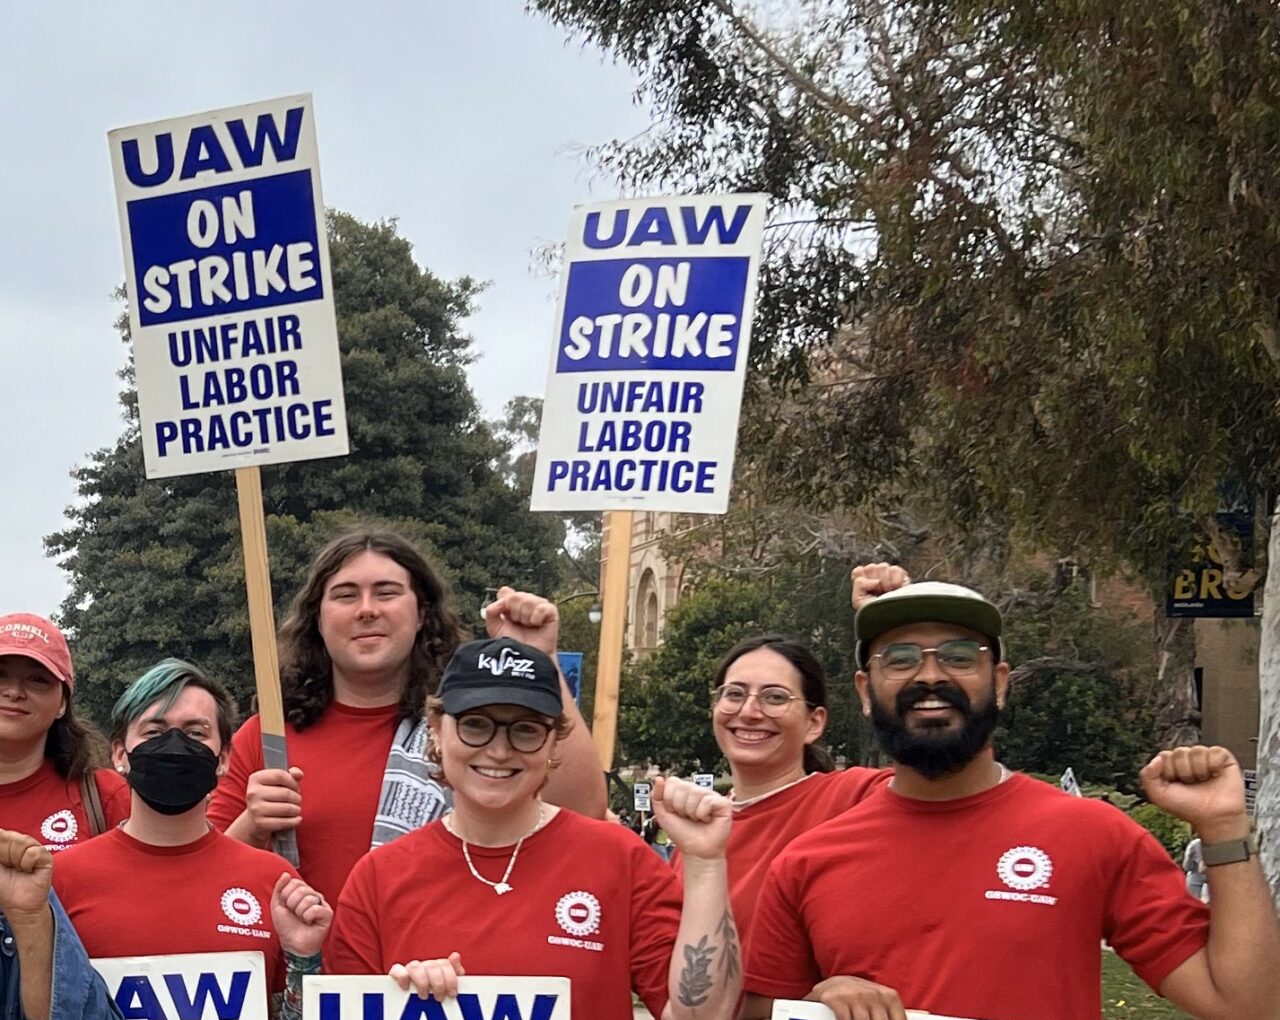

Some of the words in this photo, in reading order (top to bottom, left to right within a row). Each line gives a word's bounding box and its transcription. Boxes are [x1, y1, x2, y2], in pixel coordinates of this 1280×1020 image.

[121, 107, 304, 187] UAW
[187, 190, 255, 248] ON
[583, 205, 753, 249] UAW
[143, 242, 316, 314] STRIKE
[619, 262, 690, 308] ON
[168, 314, 302, 367] UNFAIR
[564, 313, 736, 360] STRIKE
[180, 360, 300, 410] LABOR
[577, 381, 705, 413] UNFAIR
[156, 400, 335, 457] PRACTICE
[578, 420, 692, 452] LABOR
[547, 460, 717, 493] PRACTICE
